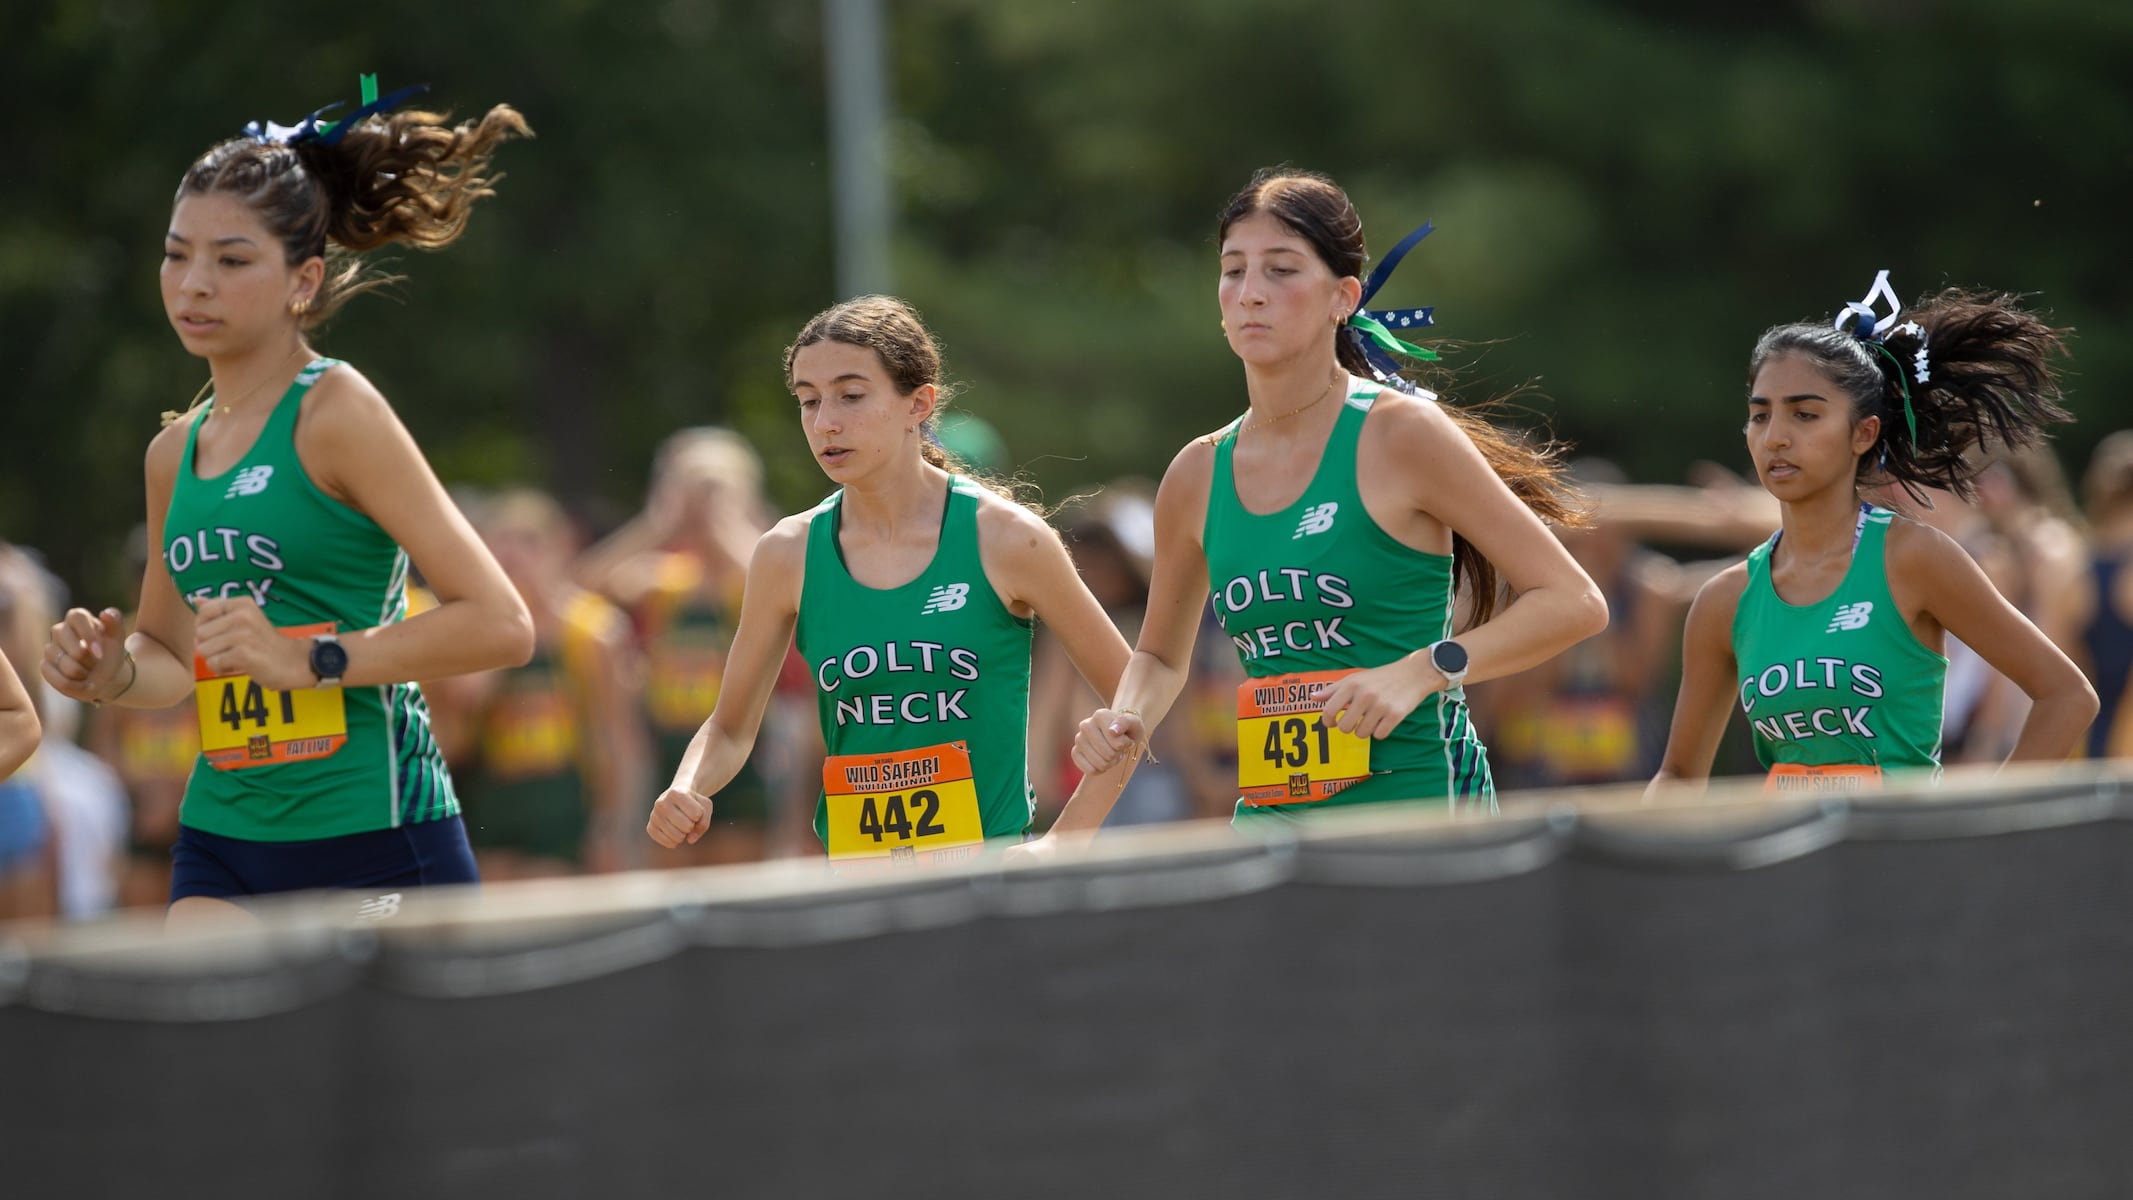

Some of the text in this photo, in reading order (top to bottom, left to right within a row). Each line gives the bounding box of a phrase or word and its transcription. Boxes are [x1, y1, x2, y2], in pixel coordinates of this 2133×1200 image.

[162, 527, 285, 574] OLTS
[1212, 567, 1355, 629] COLTS
[1232, 616, 1353, 661] NECK
[818, 640, 979, 694] COLTS
[1740, 657, 1884, 714] COLTS
[836, 688, 972, 728] NECK
[1255, 687, 1285, 706] WILD
[1264, 715, 1329, 768] 431
[1754, 706, 1878, 742] NECK
[845, 757, 940, 784] WILD SAFARI
[859, 790, 945, 843] 442
